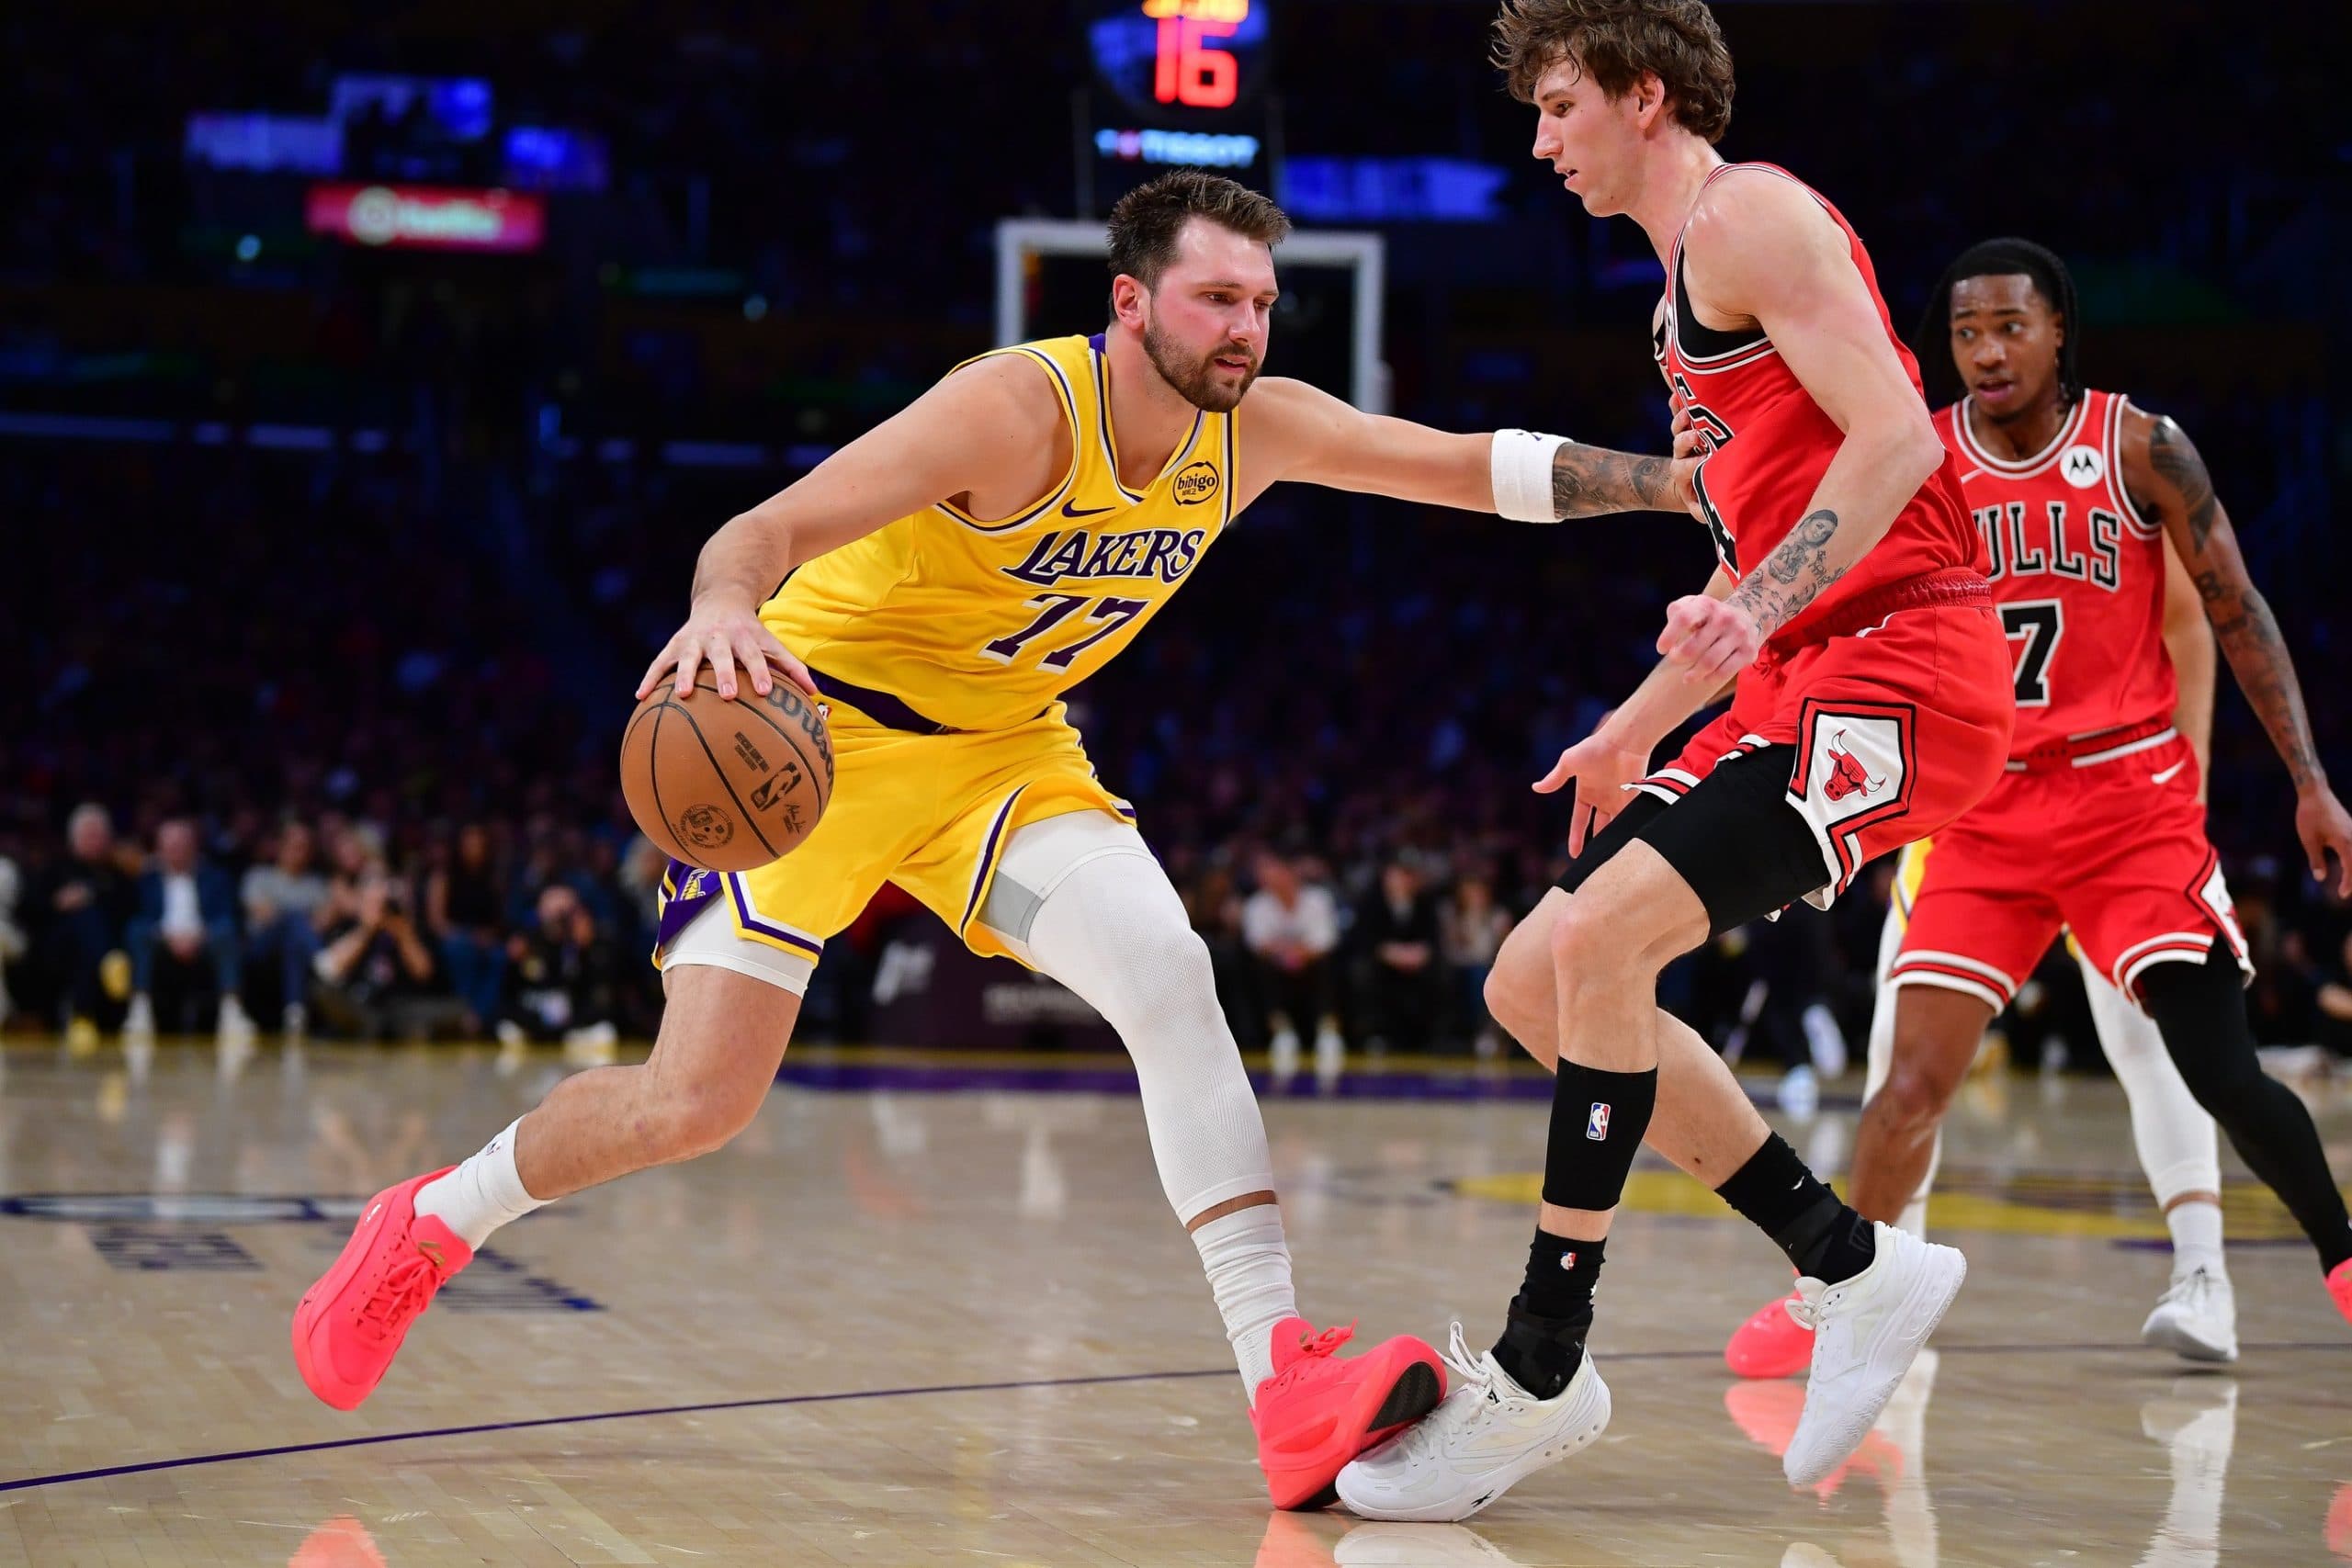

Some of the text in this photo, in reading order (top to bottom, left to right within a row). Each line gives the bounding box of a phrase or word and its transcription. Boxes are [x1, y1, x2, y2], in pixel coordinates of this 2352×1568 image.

[1155, 16, 1238, 108] 16
[1177, 473, 1216, 492] bibigo
[1001, 528, 1205, 587] LAKERS
[1973, 502, 2120, 592] ULLS
[979, 593, 1150, 675] 77
[1997, 599, 2064, 707] 7
